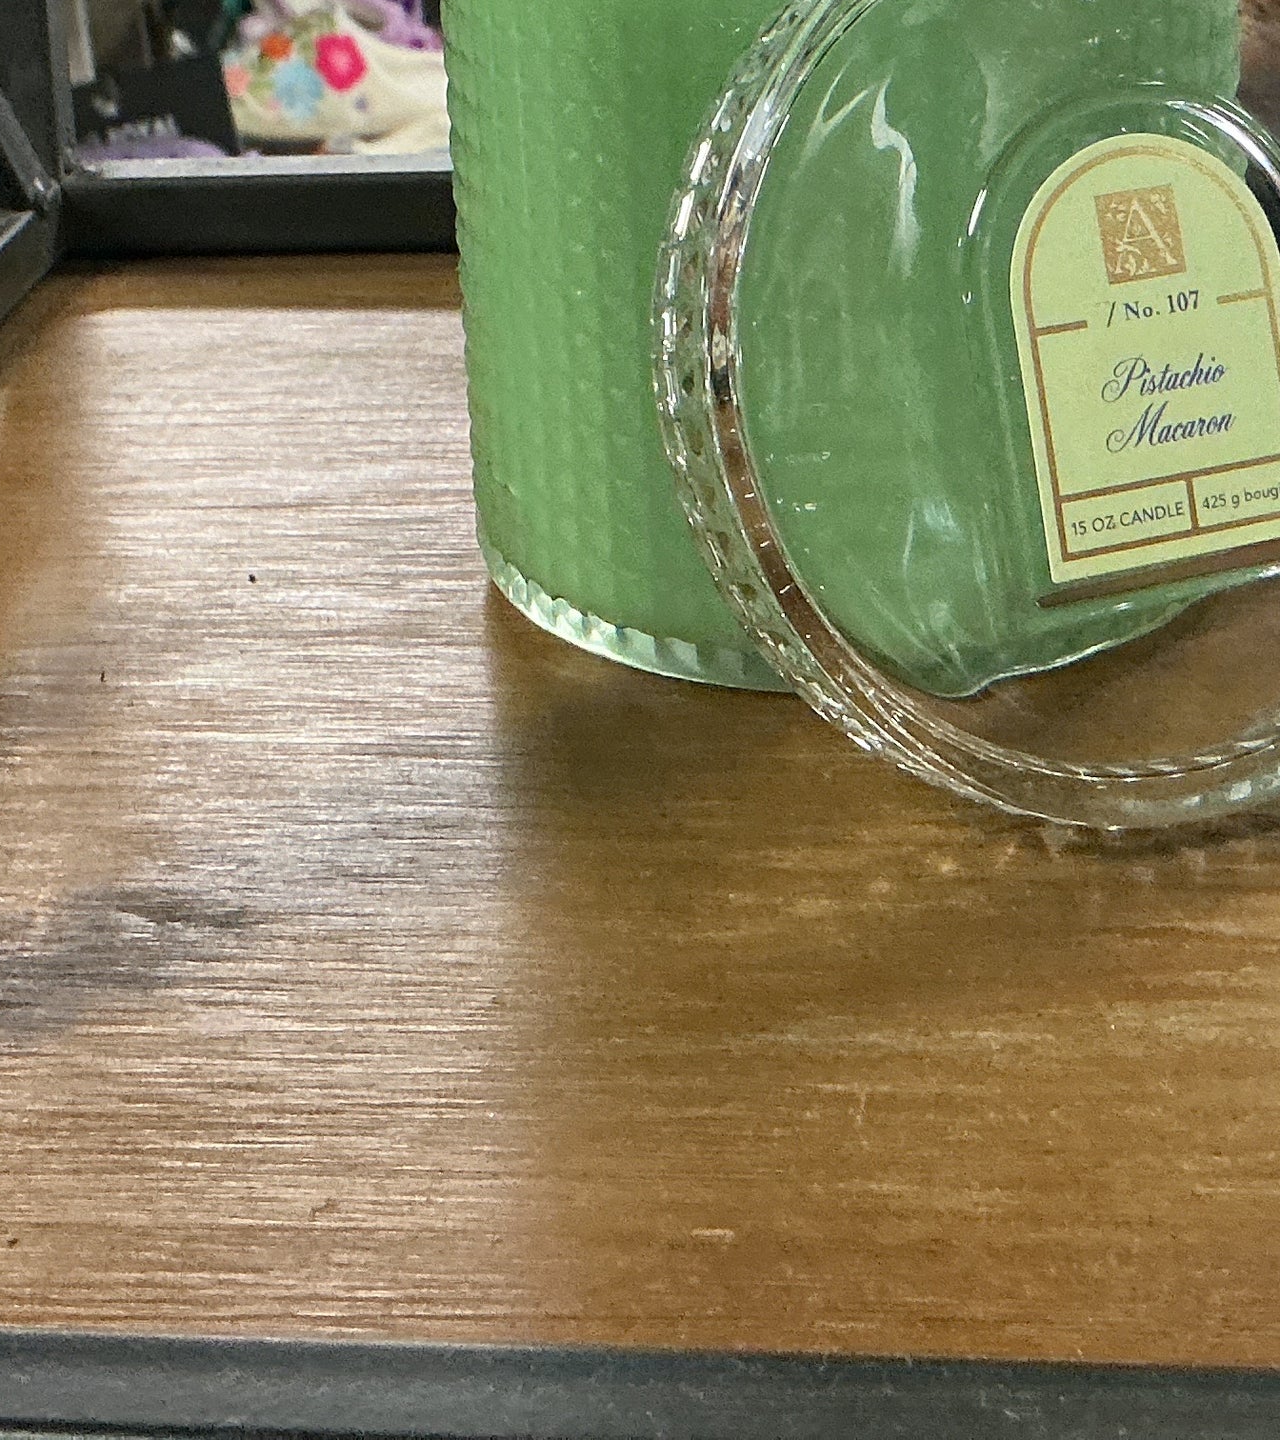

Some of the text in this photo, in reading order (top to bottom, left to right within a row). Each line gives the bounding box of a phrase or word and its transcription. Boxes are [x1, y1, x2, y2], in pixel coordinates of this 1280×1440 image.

[1123, 301, 1161, 321] No.
[1167, 289, 1199, 314] 107
[1101, 352, 1227, 403] Pistachio
[1106, 400, 1236, 453] Macaron
[1071, 521, 1087, 536] 15
[1120, 501, 1185, 527] CANDLE
[1202, 493, 1227, 510] 425
[1231, 494, 1240, 509] g
